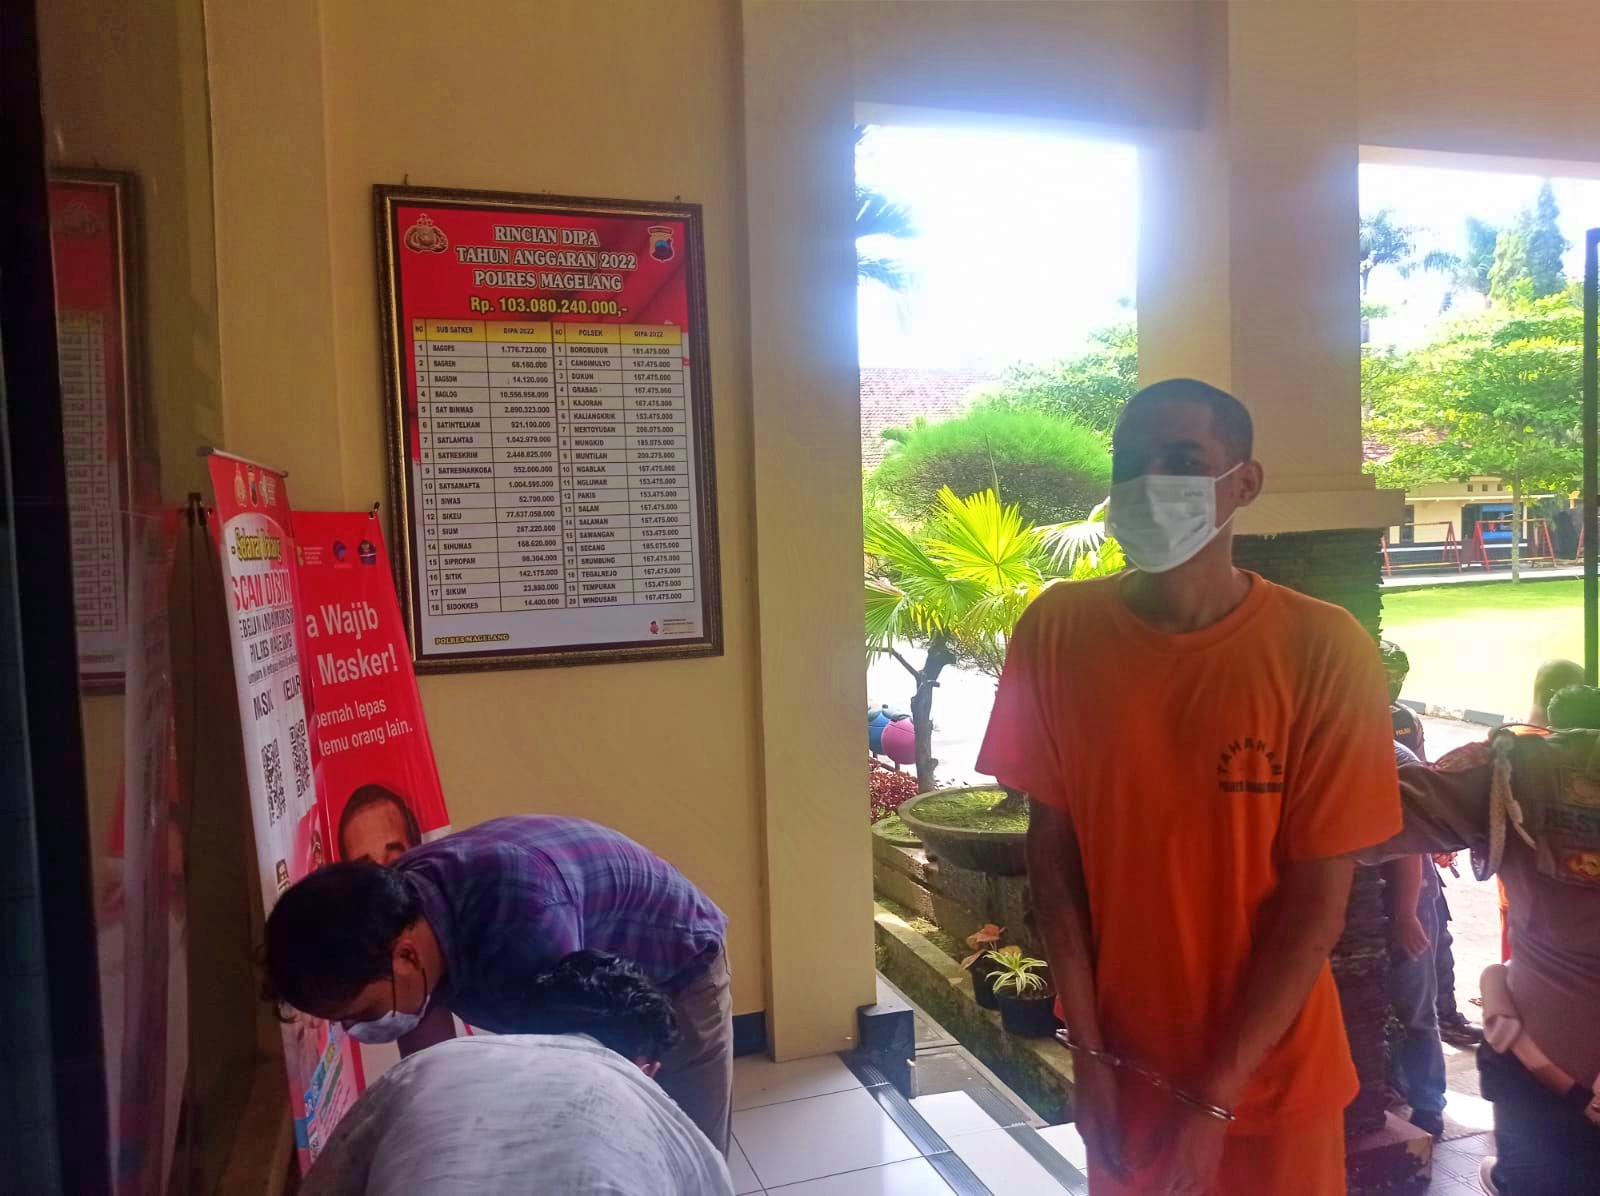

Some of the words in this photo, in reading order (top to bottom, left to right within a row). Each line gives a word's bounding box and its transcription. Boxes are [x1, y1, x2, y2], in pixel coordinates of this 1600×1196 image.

[495, 225, 557, 243] RINCIAN
[562, 228, 599, 247] DIPA
[456, 247, 509, 264] TAHUN
[513, 249, 597, 268] ANGGARAN
[600, 253, 637, 270] 2022
[474, 270, 536, 287] POLRES
[540, 273, 622, 292] MAGELANG
[470, 297, 494, 314] Rp.
[500, 298, 628, 316] 103.080.240.000,-
[320, 601, 378, 640] Wajib
[465, 633, 509, 642] MAGELANG
[317, 643, 398, 686] Masker!
[354, 699, 386, 720] lepas
[352, 727, 385, 747] orang
[386, 718, 413, 737] lain.
